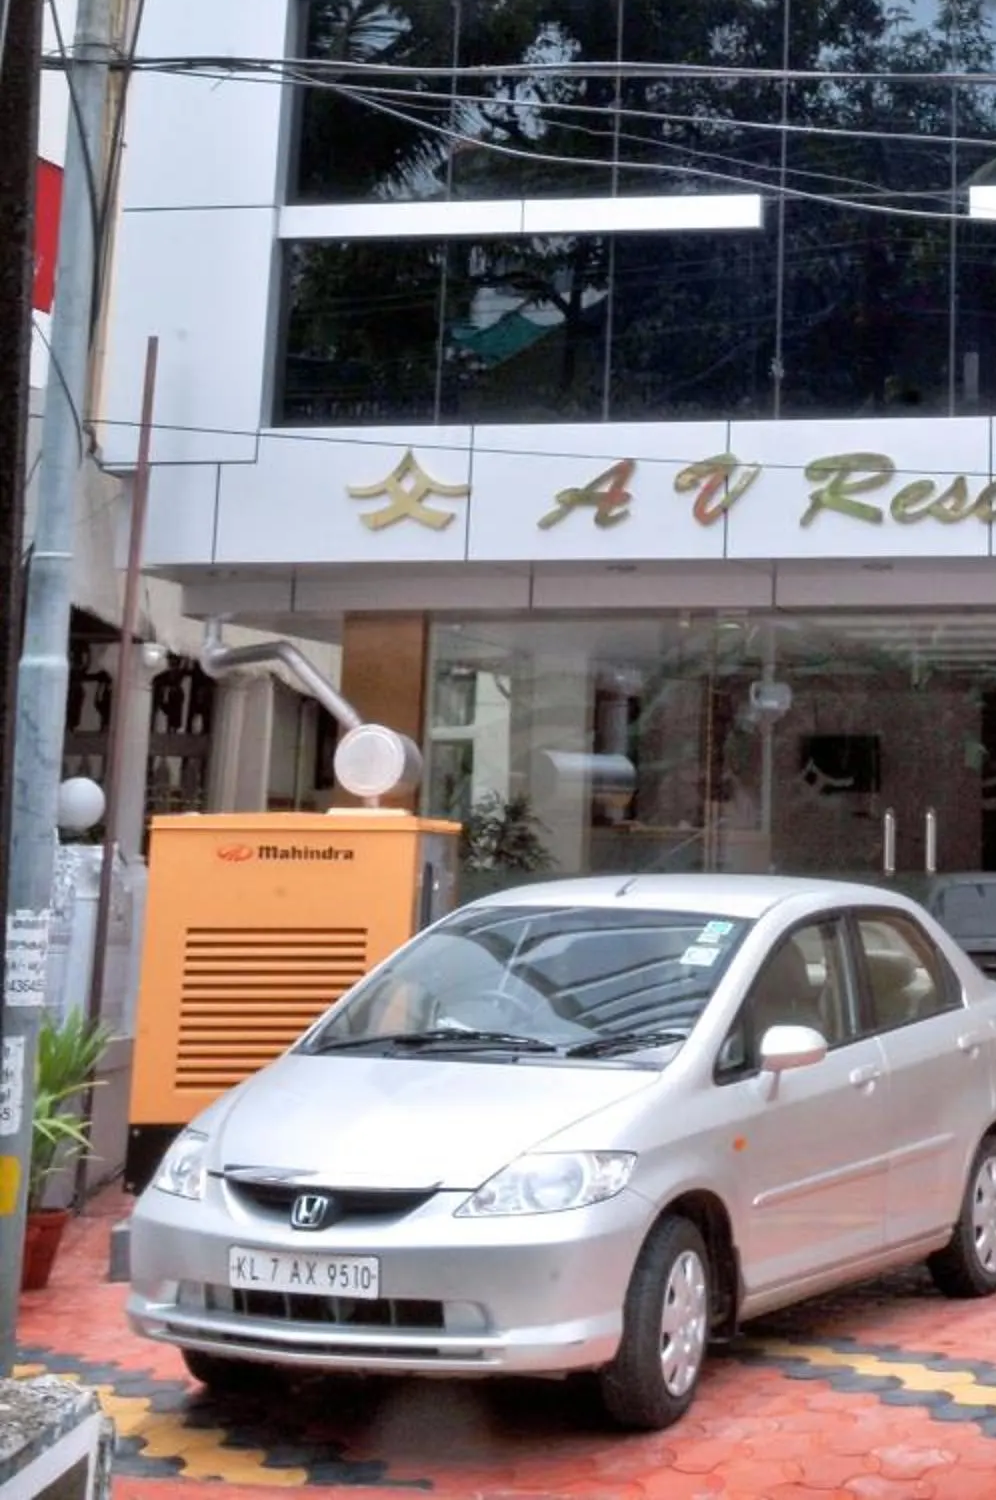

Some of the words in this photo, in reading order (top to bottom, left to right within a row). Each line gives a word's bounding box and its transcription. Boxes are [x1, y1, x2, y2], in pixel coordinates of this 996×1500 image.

[537, 457, 635, 530] A
[674, 452, 762, 526] V
[258, 844, 354, 861] Mahindra
[236, 1256, 260, 1282] KL
[271, 1257, 280, 1282] 7
[289, 1259, 318, 1286] AX
[327, 1263, 372, 1290] 9510
